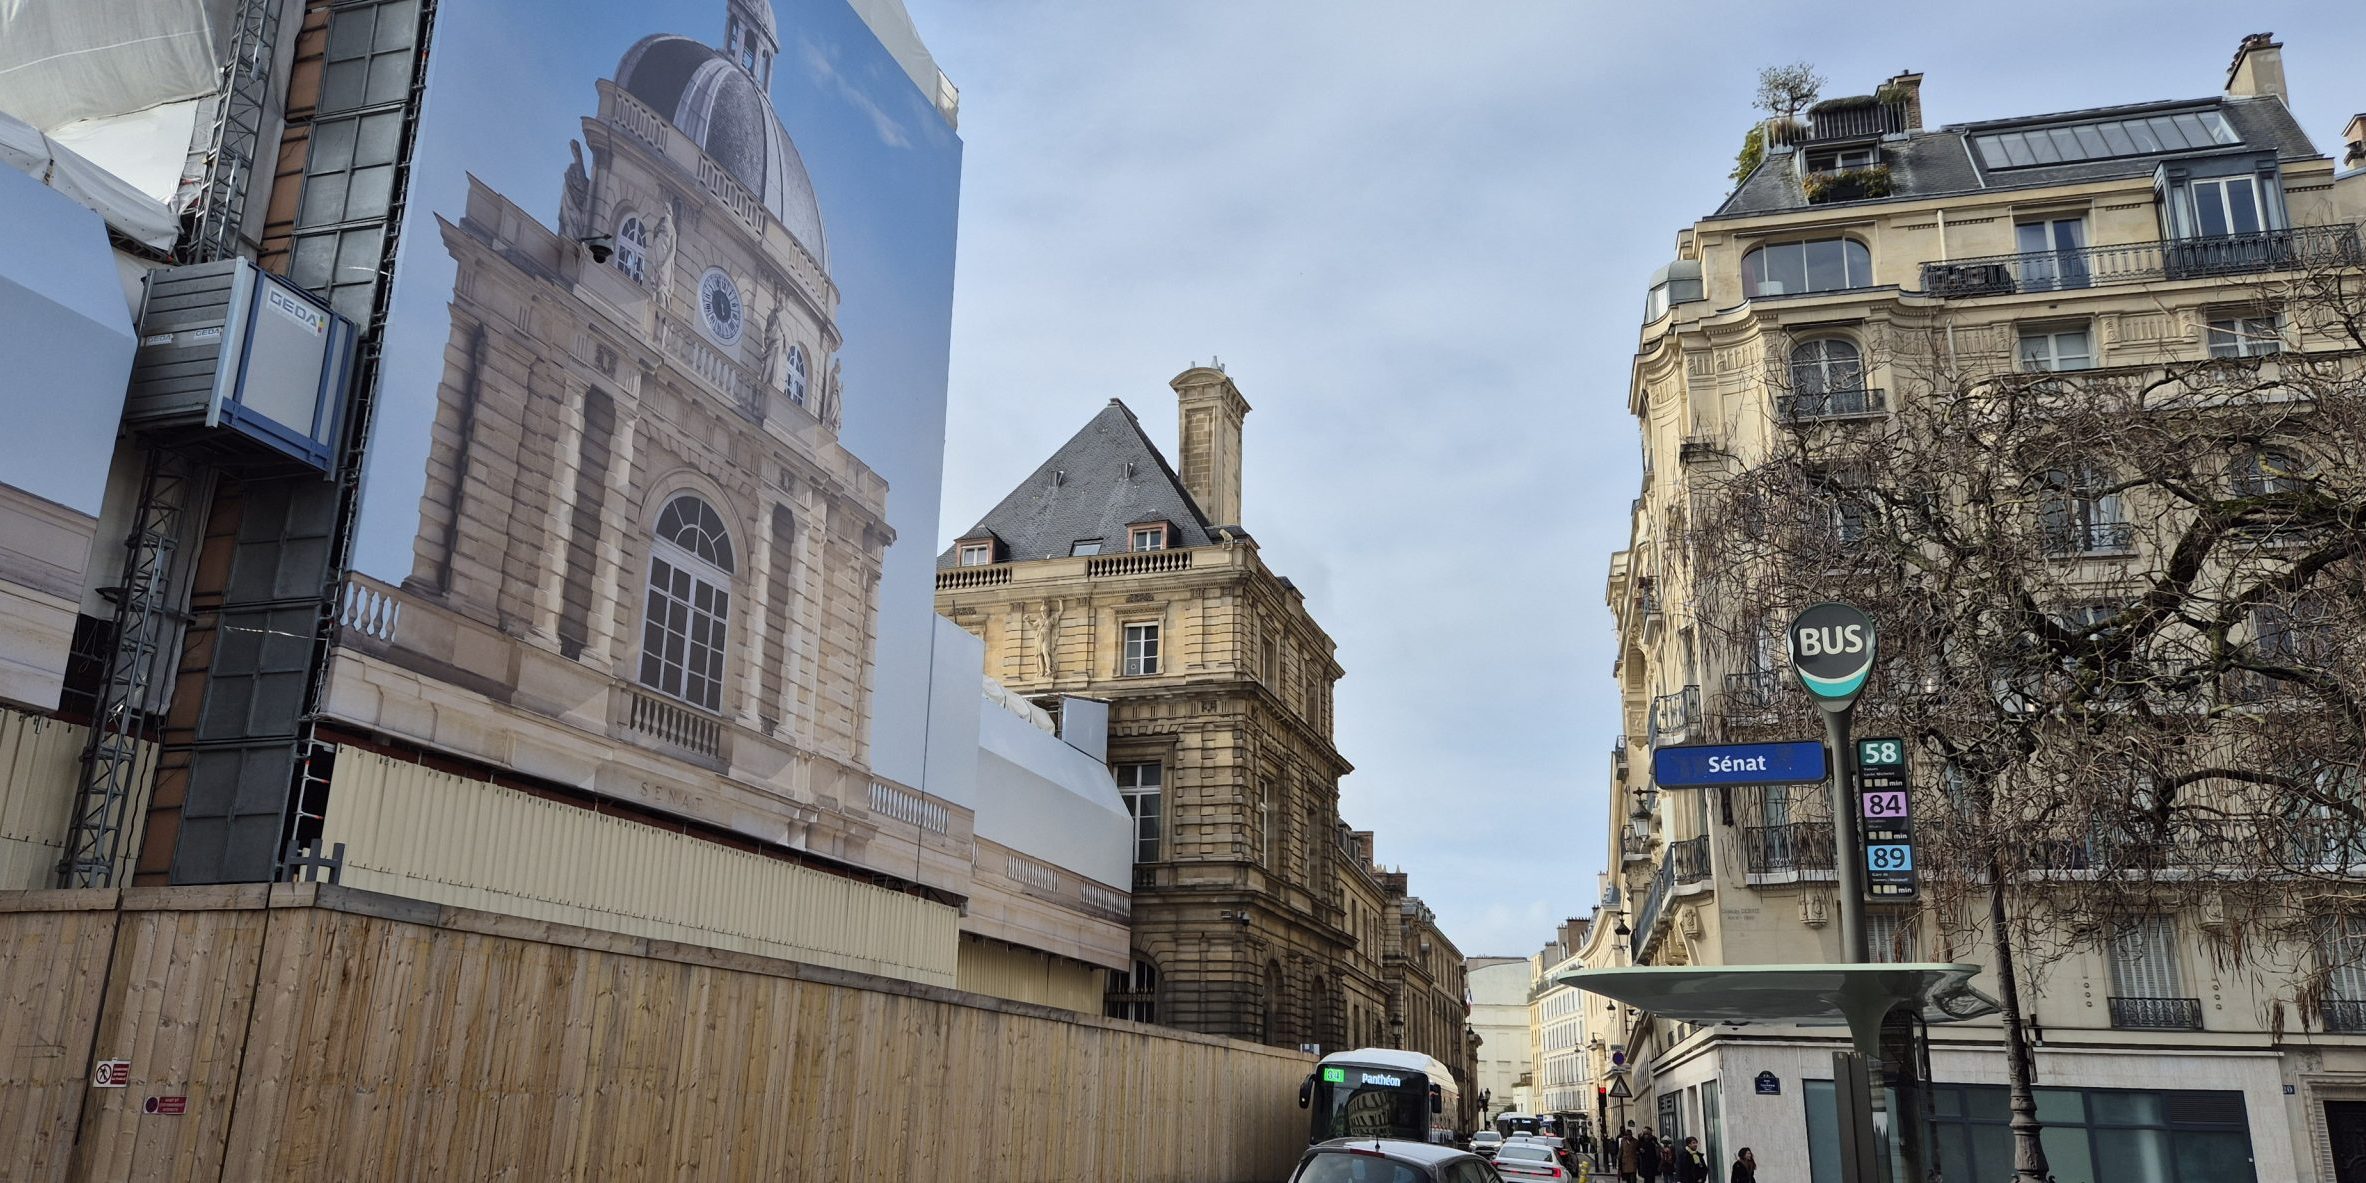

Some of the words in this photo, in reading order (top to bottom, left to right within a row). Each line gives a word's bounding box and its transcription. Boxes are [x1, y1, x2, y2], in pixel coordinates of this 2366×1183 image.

[270, 290, 317, 327] GEDA
[147, 335, 171, 343] GEDA
[196, 328, 220, 337] GEDA
[1800, 624, 1863, 657] BUS
[1708, 754, 1767, 773] Sénat
[1865, 742, 1897, 764] 58
[640, 782, 703, 813] SENAT
[1869, 794, 1902, 815] 84
[1873, 847, 1906, 868] 89
[1898, 886, 1912, 894] min
[1362, 1072, 1401, 1087] Panthéon
